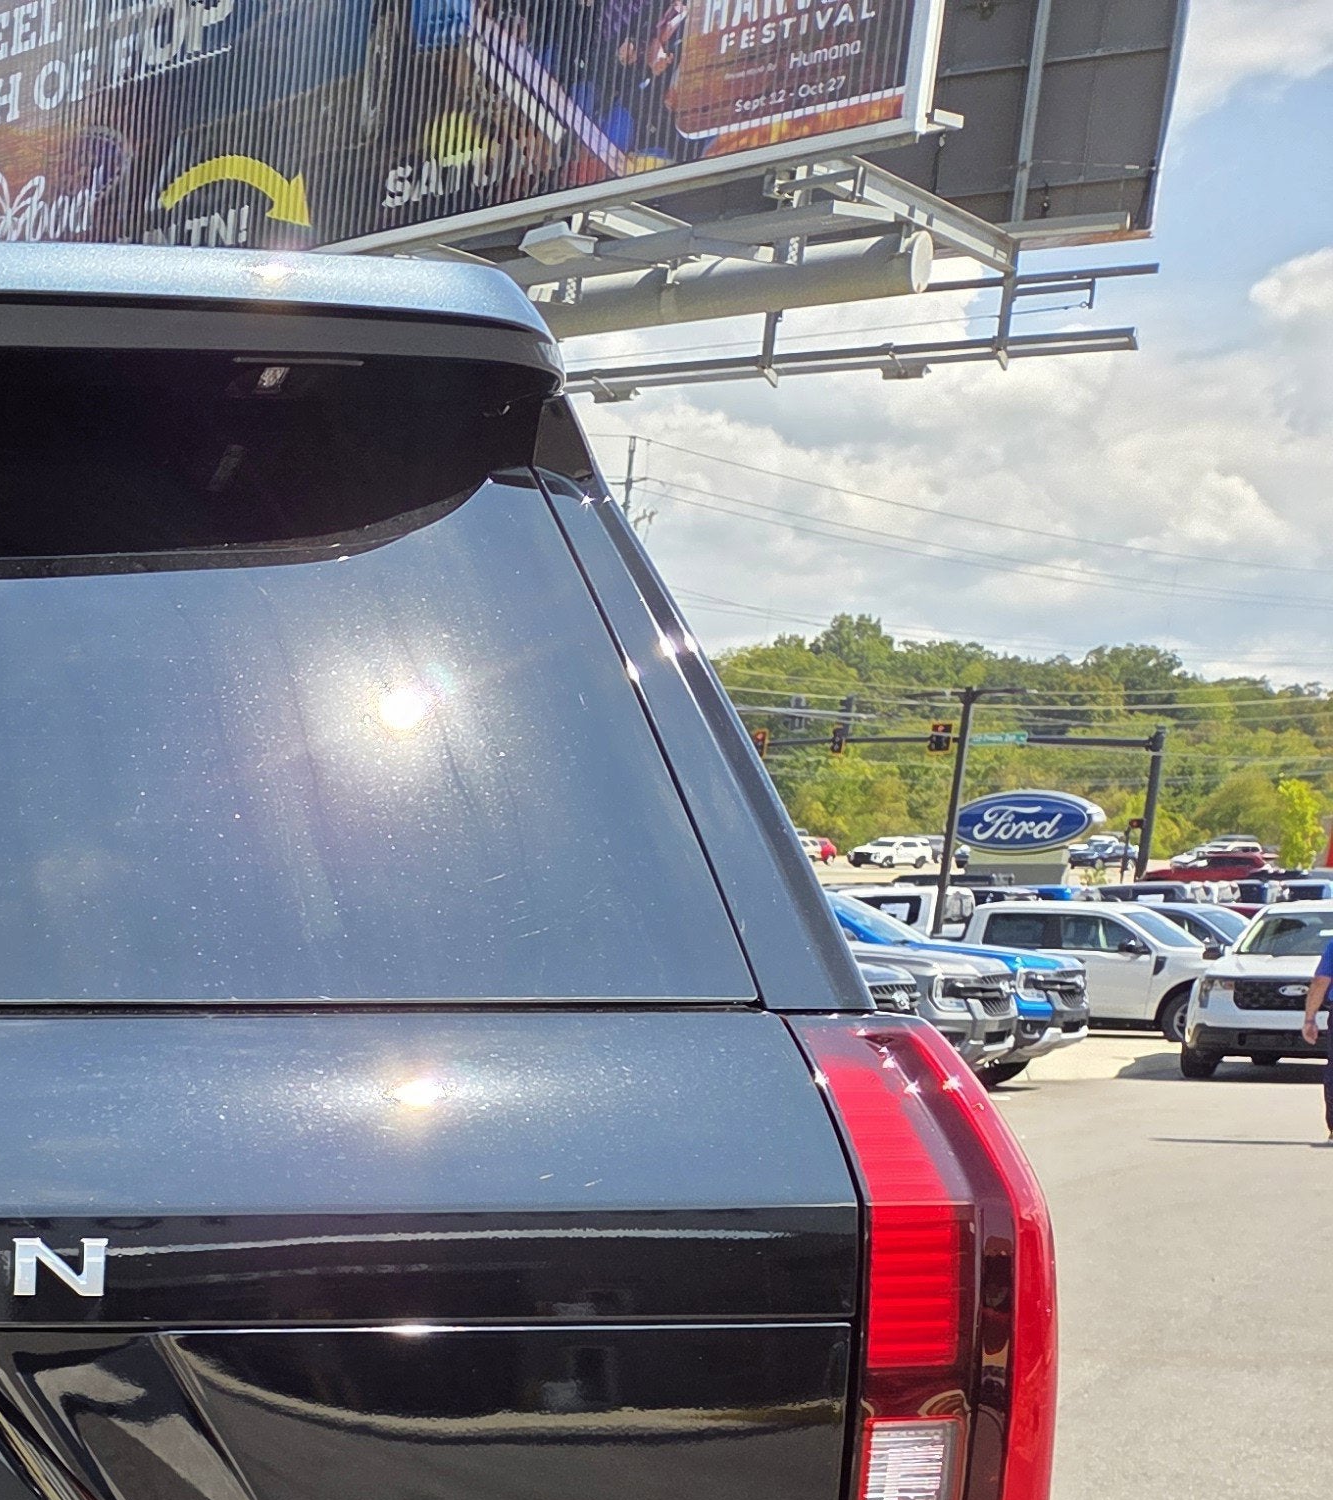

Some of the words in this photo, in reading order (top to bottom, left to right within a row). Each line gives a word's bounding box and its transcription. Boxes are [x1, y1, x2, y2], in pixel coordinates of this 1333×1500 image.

[720, 0, 876, 54] FESTIVAL
[789, 39, 861, 70] Humana
[735, 96, 767, 113] Sept
[769, 90, 786, 105] 12
[798, 81, 824, 98] Oct
[827, 75, 846, 91] 27
[972, 805, 1064, 840] Ford
